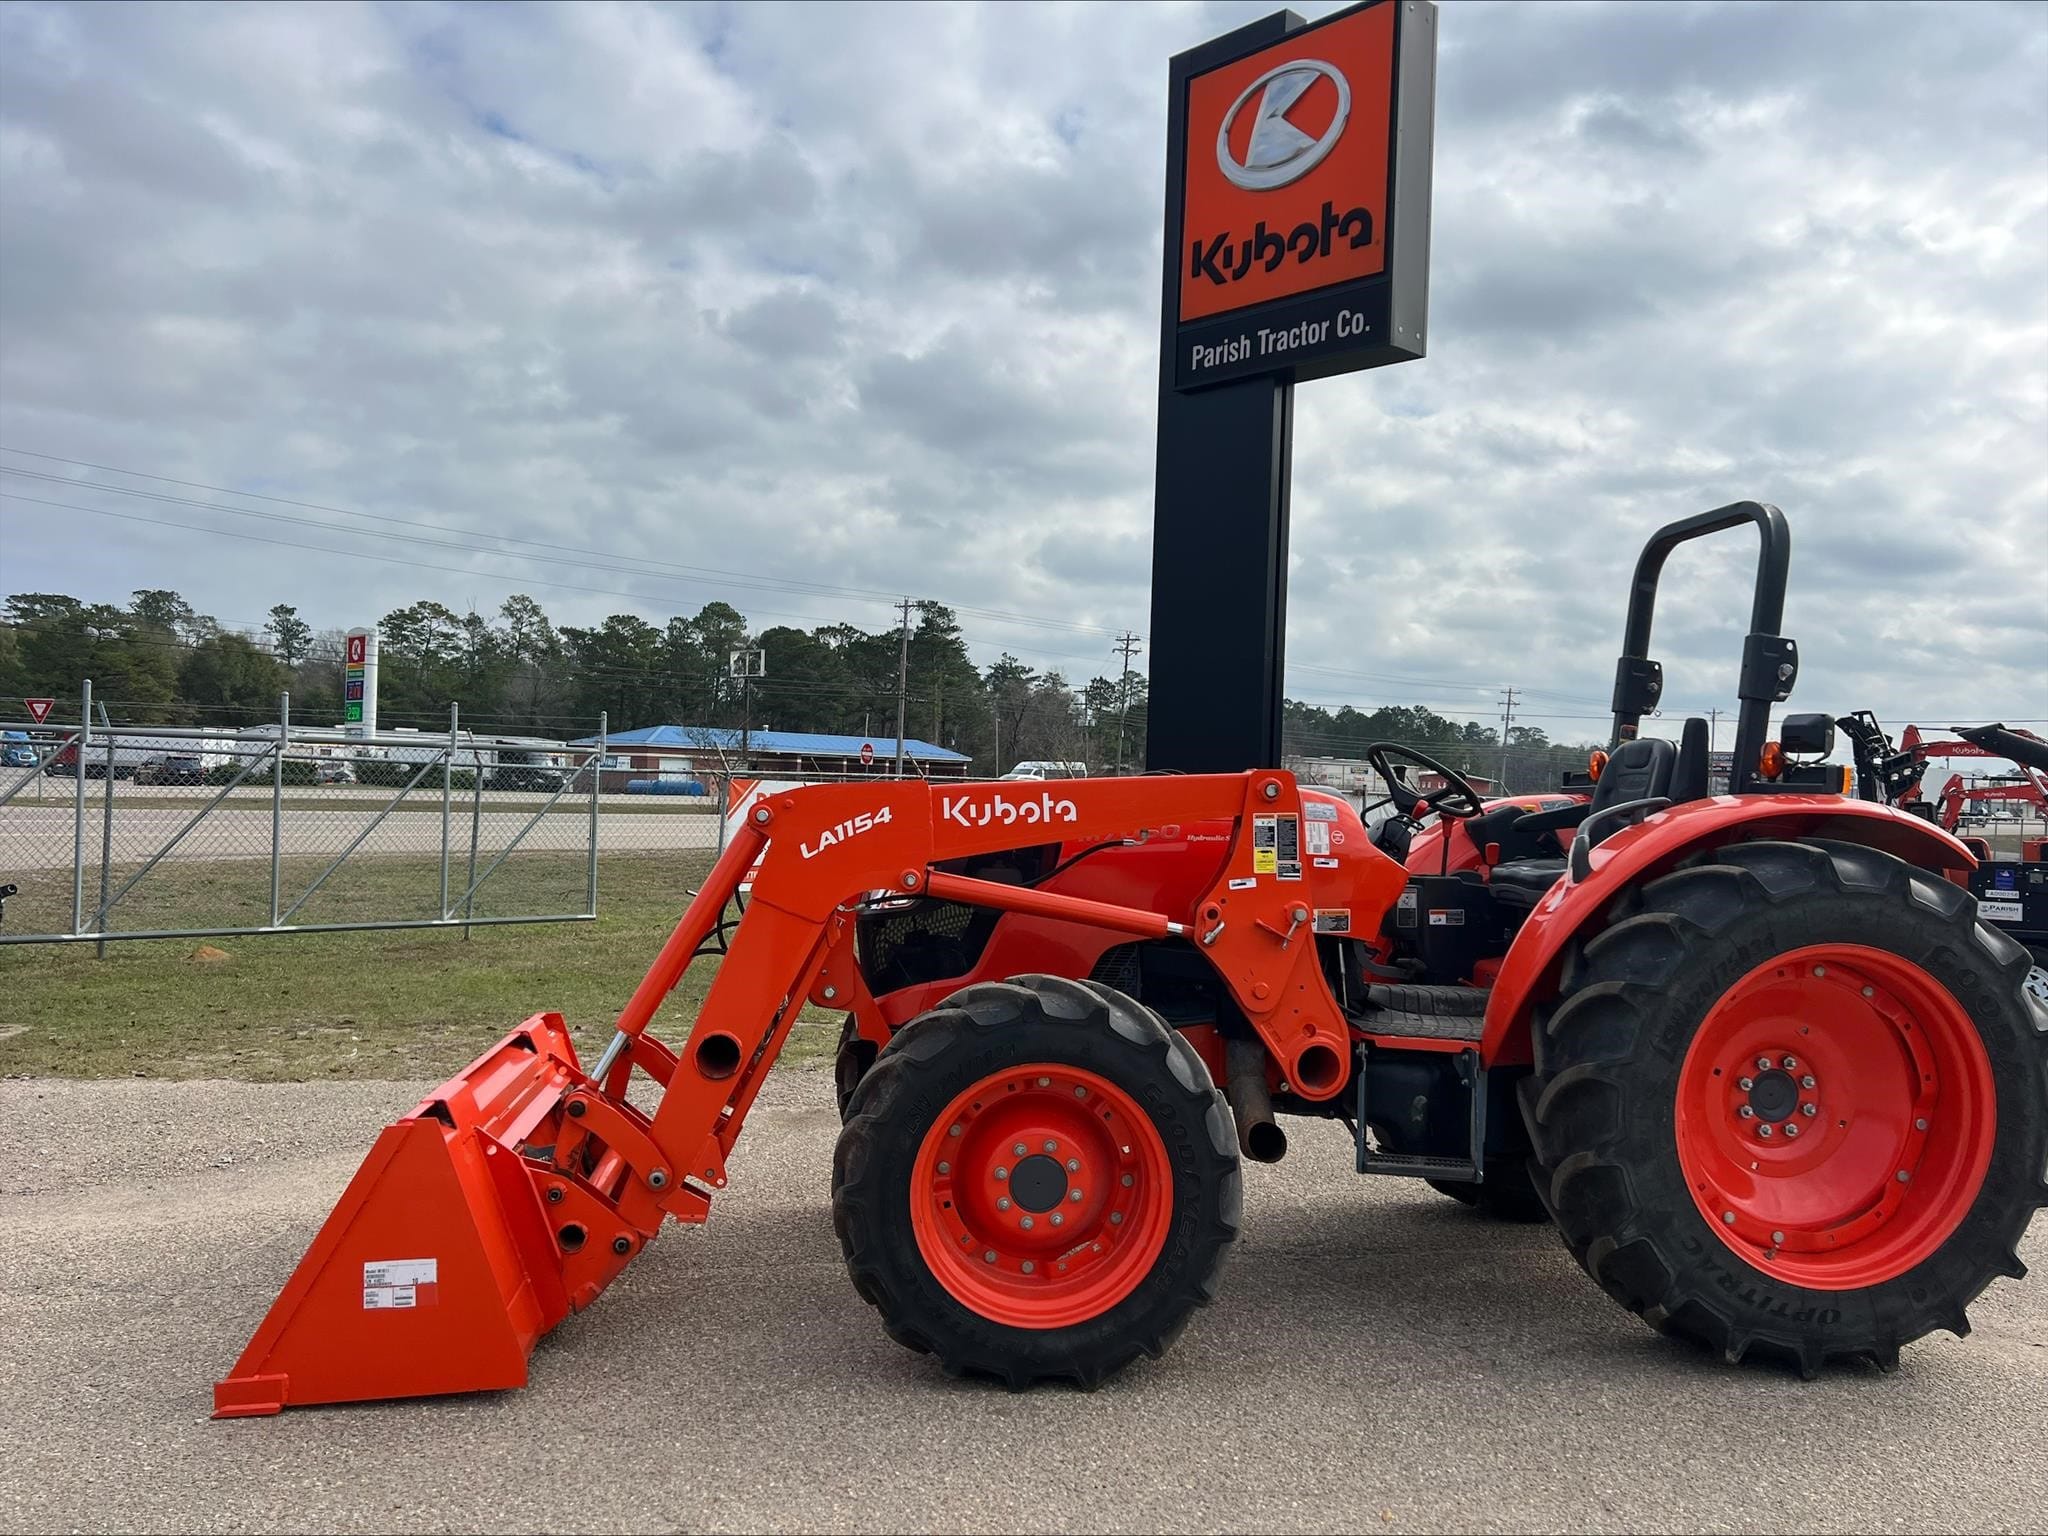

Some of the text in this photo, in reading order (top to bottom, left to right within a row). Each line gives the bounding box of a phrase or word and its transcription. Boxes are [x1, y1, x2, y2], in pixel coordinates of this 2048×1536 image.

[1192, 201, 1373, 285] Kubota
[1192, 309, 1371, 371] Parish Tractor Co.
[1952, 746, 1985, 755] Kubota
[799, 806, 893, 860] LA1154
[943, 792, 1077, 827] Kubota
[1186, 834, 1224, 842] Hydraulic
[1144, 1083, 1200, 1291] GOODYEAR
